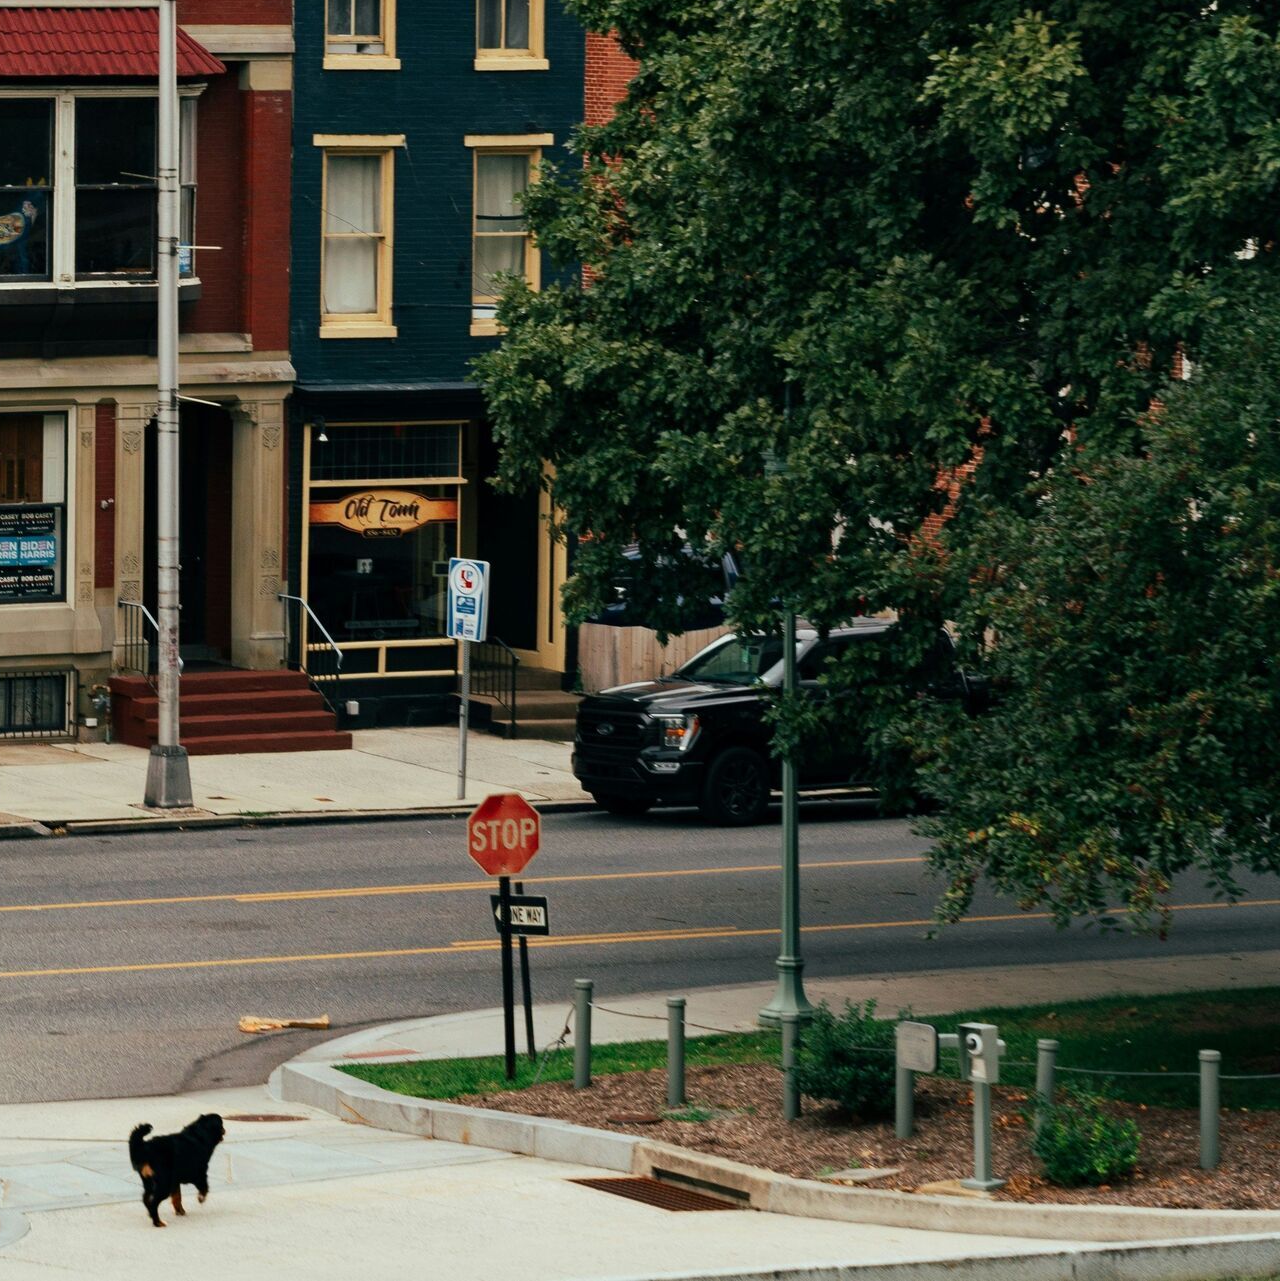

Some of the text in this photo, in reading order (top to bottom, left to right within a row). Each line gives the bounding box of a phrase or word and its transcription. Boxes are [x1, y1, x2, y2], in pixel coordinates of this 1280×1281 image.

[345, 495, 421, 524] Old Town
[21, 540, 54, 551] BIDEN
[20, 550, 55, 559] HARRIS
[471, 818, 537, 852] STOP
[512, 907, 542, 923] NE WAY
